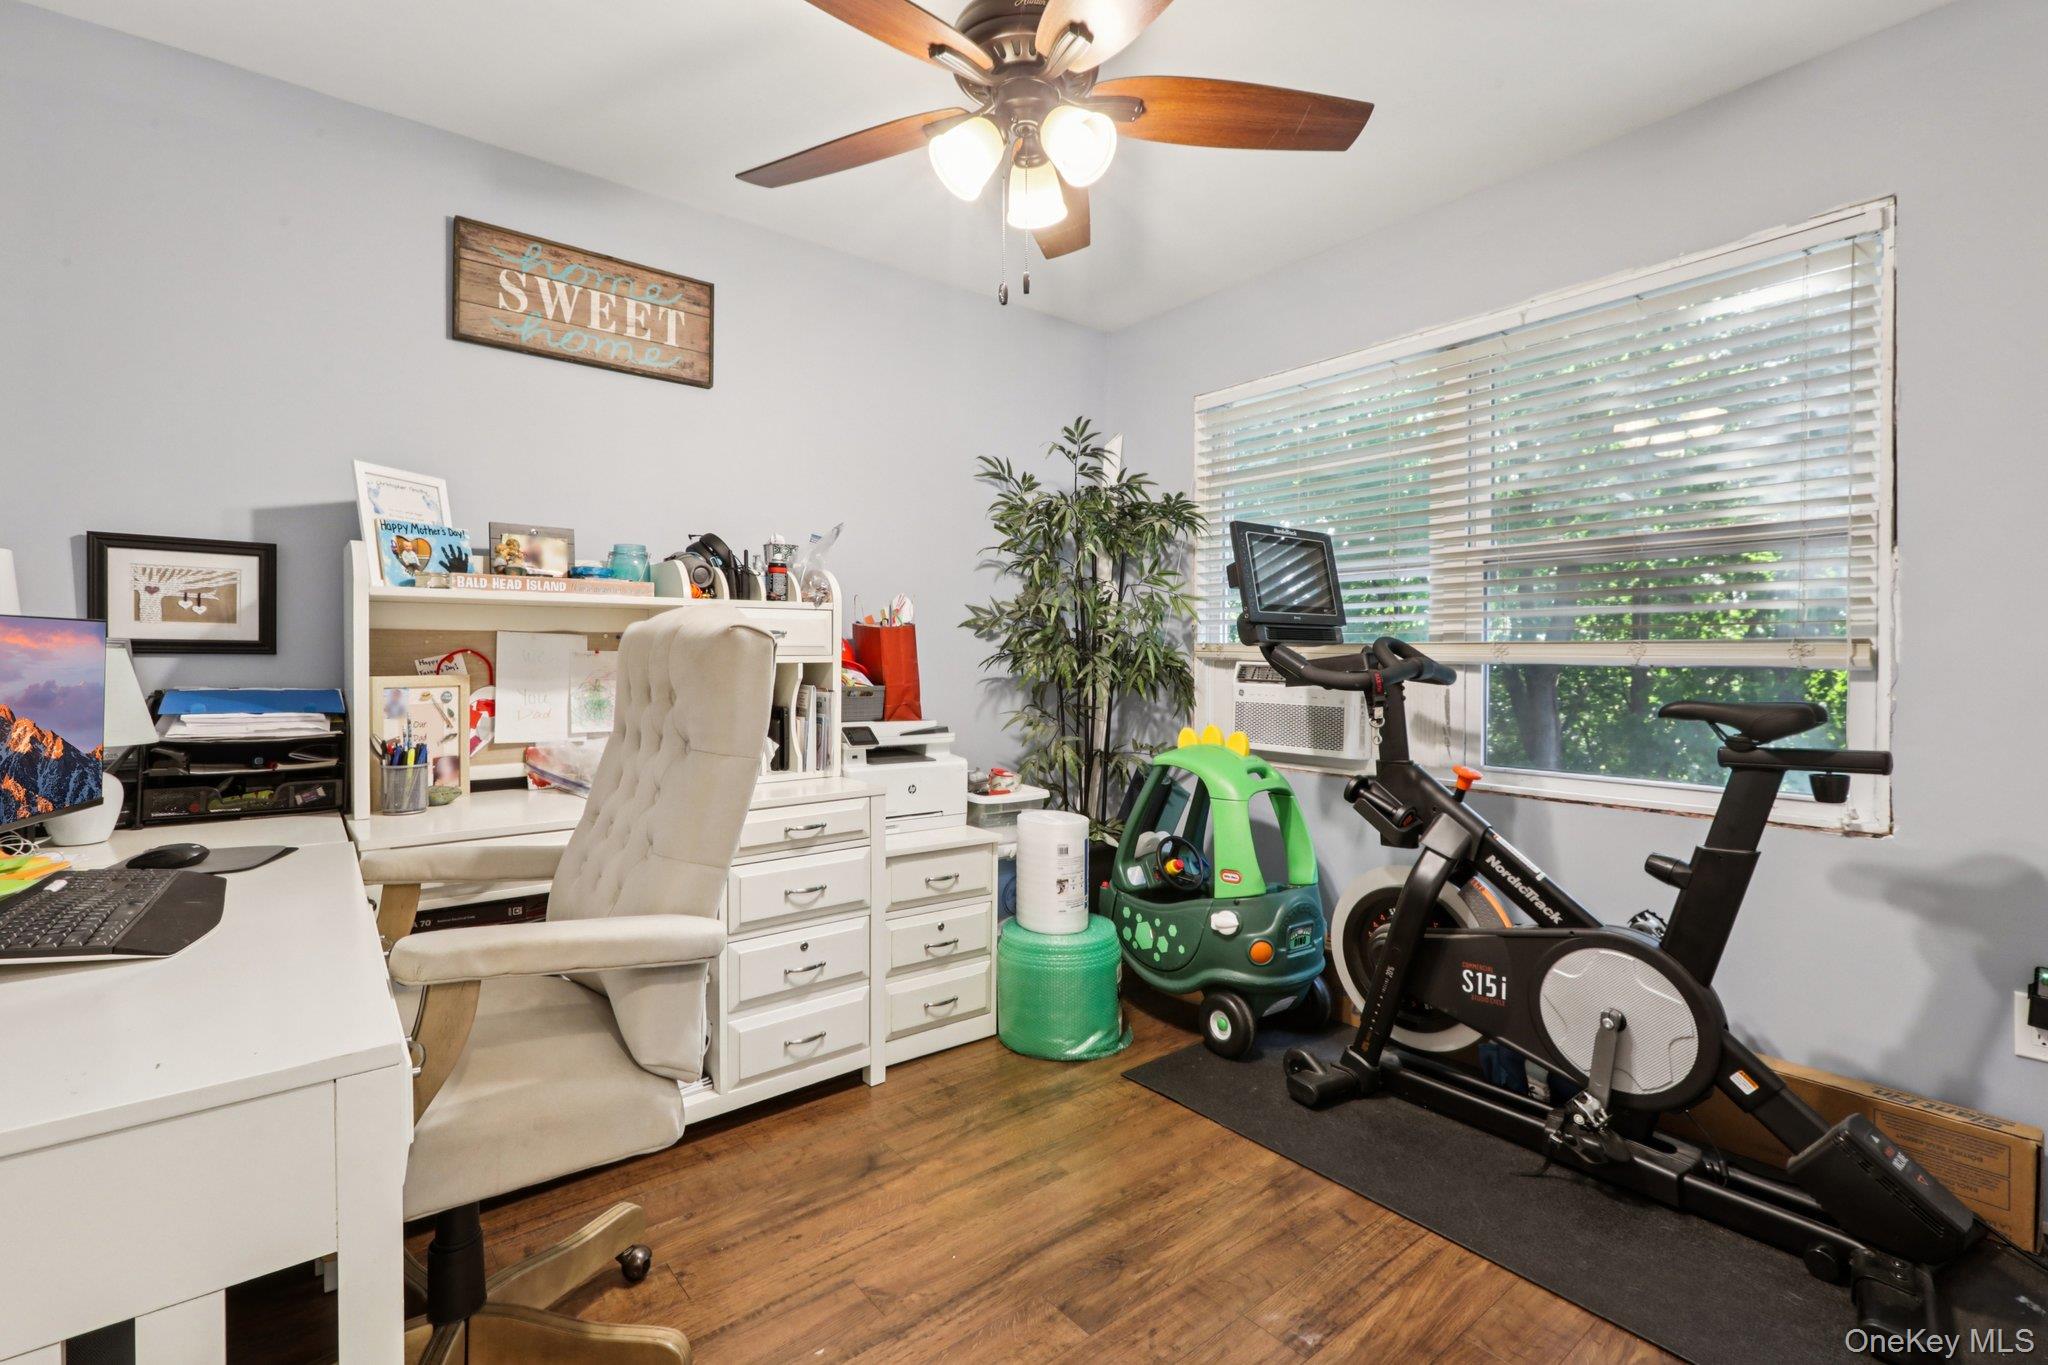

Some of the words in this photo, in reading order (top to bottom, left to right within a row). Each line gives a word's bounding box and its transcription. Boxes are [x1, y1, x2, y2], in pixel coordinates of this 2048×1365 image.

[491, 243, 684, 305] home
[498, 268, 685, 347] SWEET
[490, 311, 682, 368] home
[380, 519, 409, 534] Happy
[410, 522, 446, 536] Mother's
[447, 527, 465, 539] Day!
[456, 575, 487, 588] BALD
[491, 577, 522, 590] HEAD
[526, 578, 567, 592] ISLAND
[516, 708, 552, 721] Dad
[1485, 854, 1564, 925] NordicTrack
